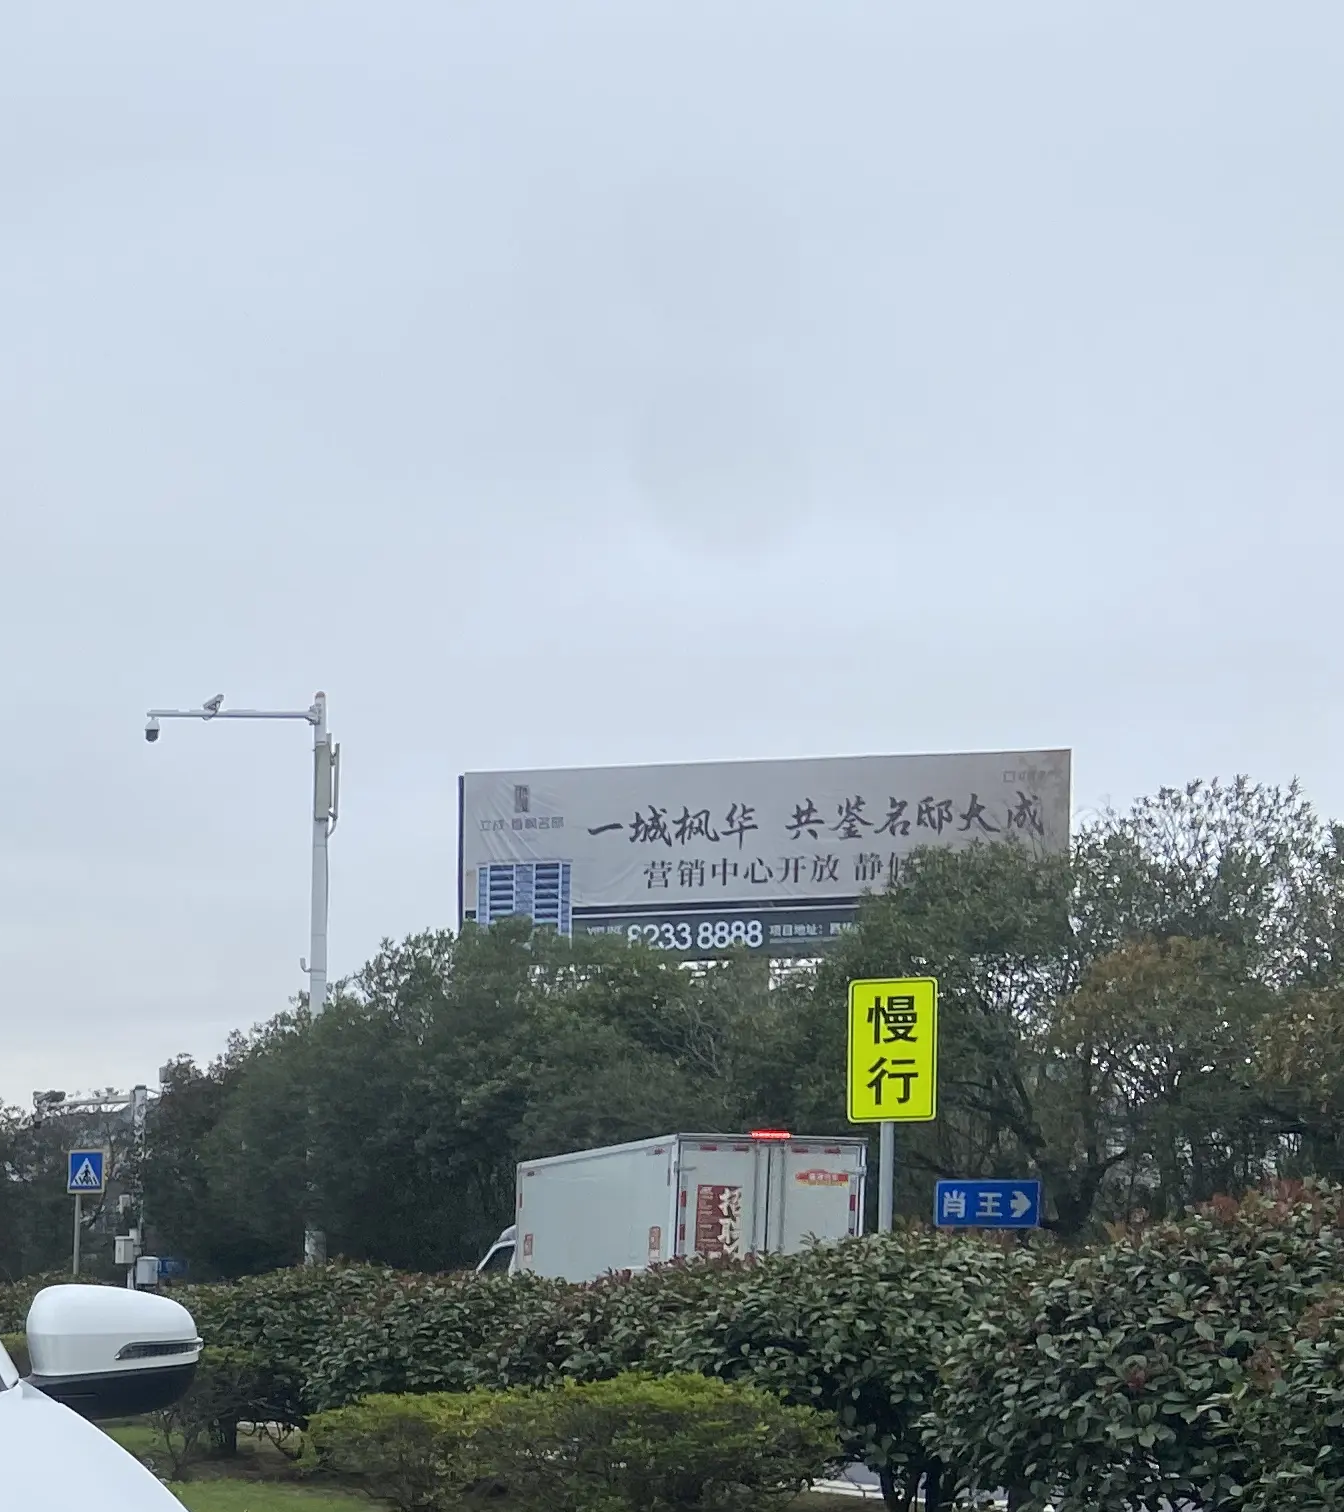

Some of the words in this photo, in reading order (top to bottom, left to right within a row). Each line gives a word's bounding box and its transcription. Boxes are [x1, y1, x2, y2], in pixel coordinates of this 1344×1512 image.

[588, 802, 759, 850] 一城枫华
[785, 791, 1044, 840] 共鉴名邸大成
[643, 853, 839, 889] 营销中心开放
[697, 920, 762, 949] 8888
[867, 995, 919, 1106] 慢行
[943, 1189, 1003, 1218] 肖王
